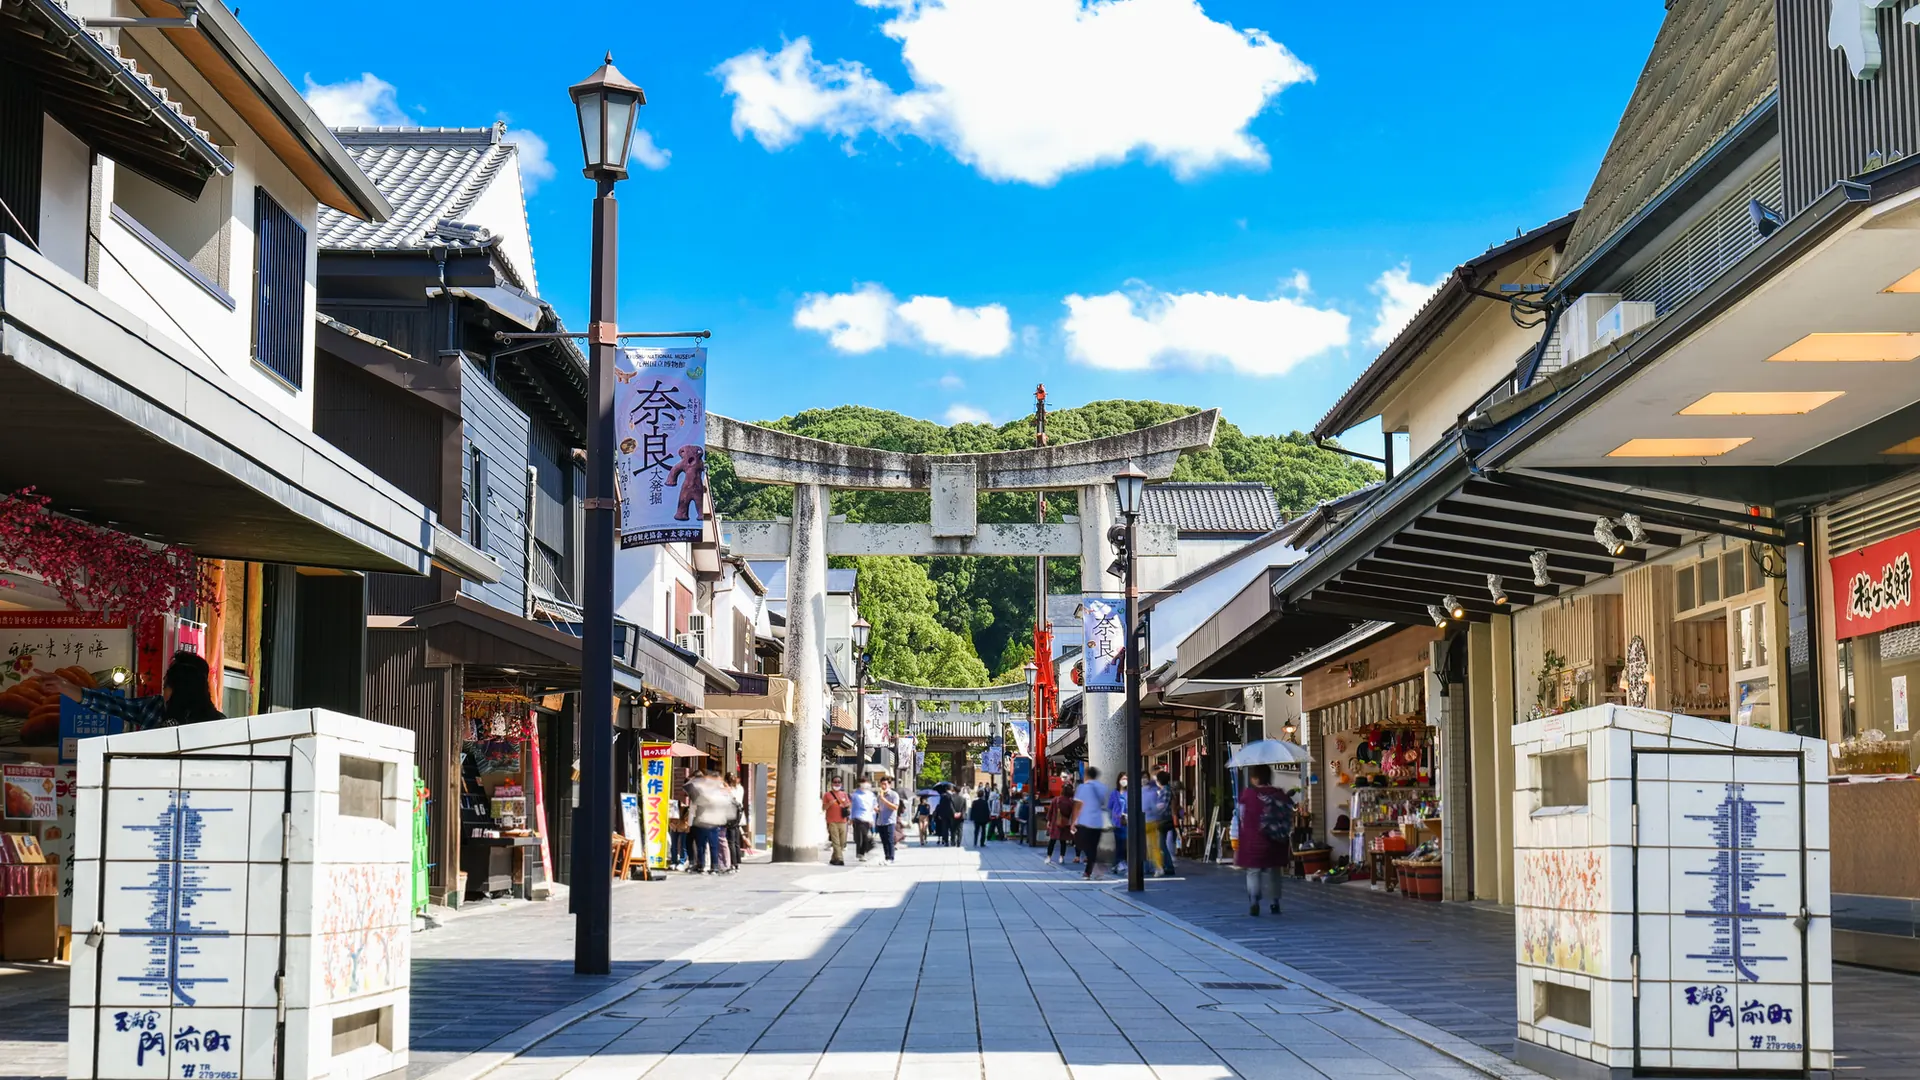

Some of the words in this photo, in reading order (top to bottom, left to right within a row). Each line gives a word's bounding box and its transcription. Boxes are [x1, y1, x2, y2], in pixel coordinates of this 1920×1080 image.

[636, 360, 686, 369] 九州国立博物館
[631, 380, 686, 477] 奈良
[649, 467, 664, 505] 大発掘
[1093, 614, 1119, 660] 奈良
[869, 704, 884, 730] 奈良
[647, 760, 664, 840] 新作マスク
[1708, 999, 1793, 1037] 門前町
[137, 1025, 231, 1067] 門前町
[199, 1063, 211, 1071] TR
